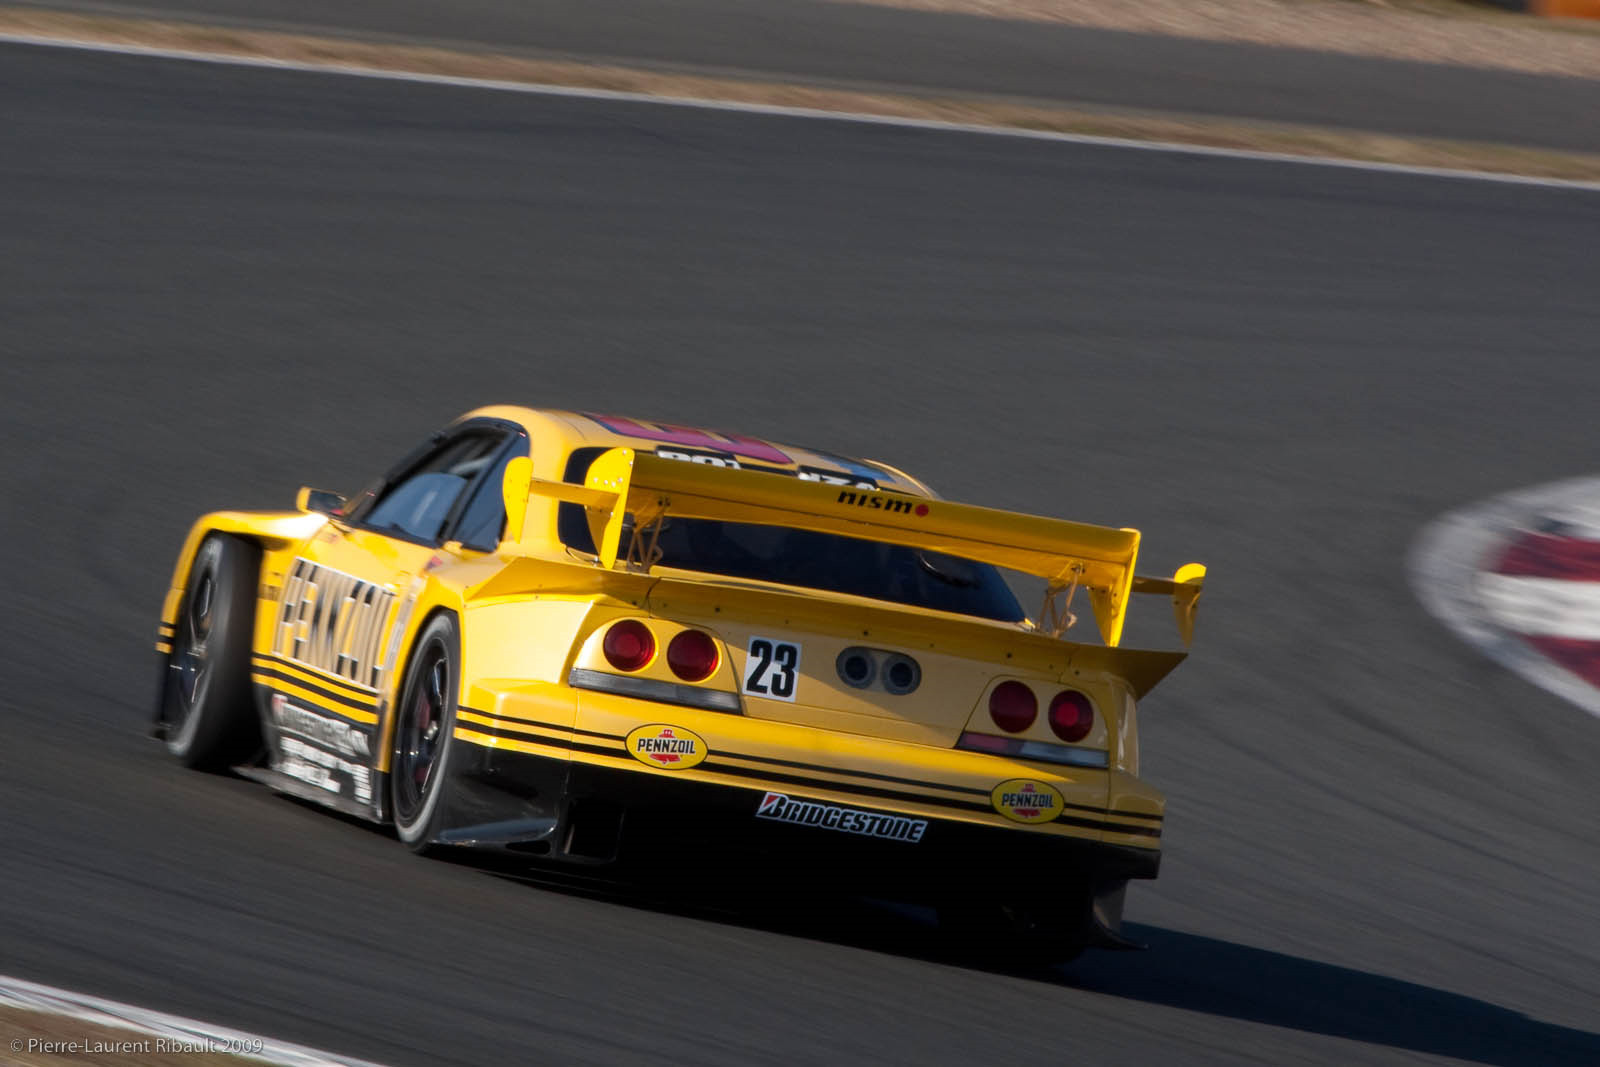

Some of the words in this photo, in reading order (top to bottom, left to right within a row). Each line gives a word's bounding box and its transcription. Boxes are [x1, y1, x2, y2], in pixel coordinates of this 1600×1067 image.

[746, 638, 798, 698] 23
[637, 737, 696, 755] PENNZOIL
[757, 792, 928, 842] BRIDGESTONE
[1001, 792, 1054, 809] PENNZOIL
